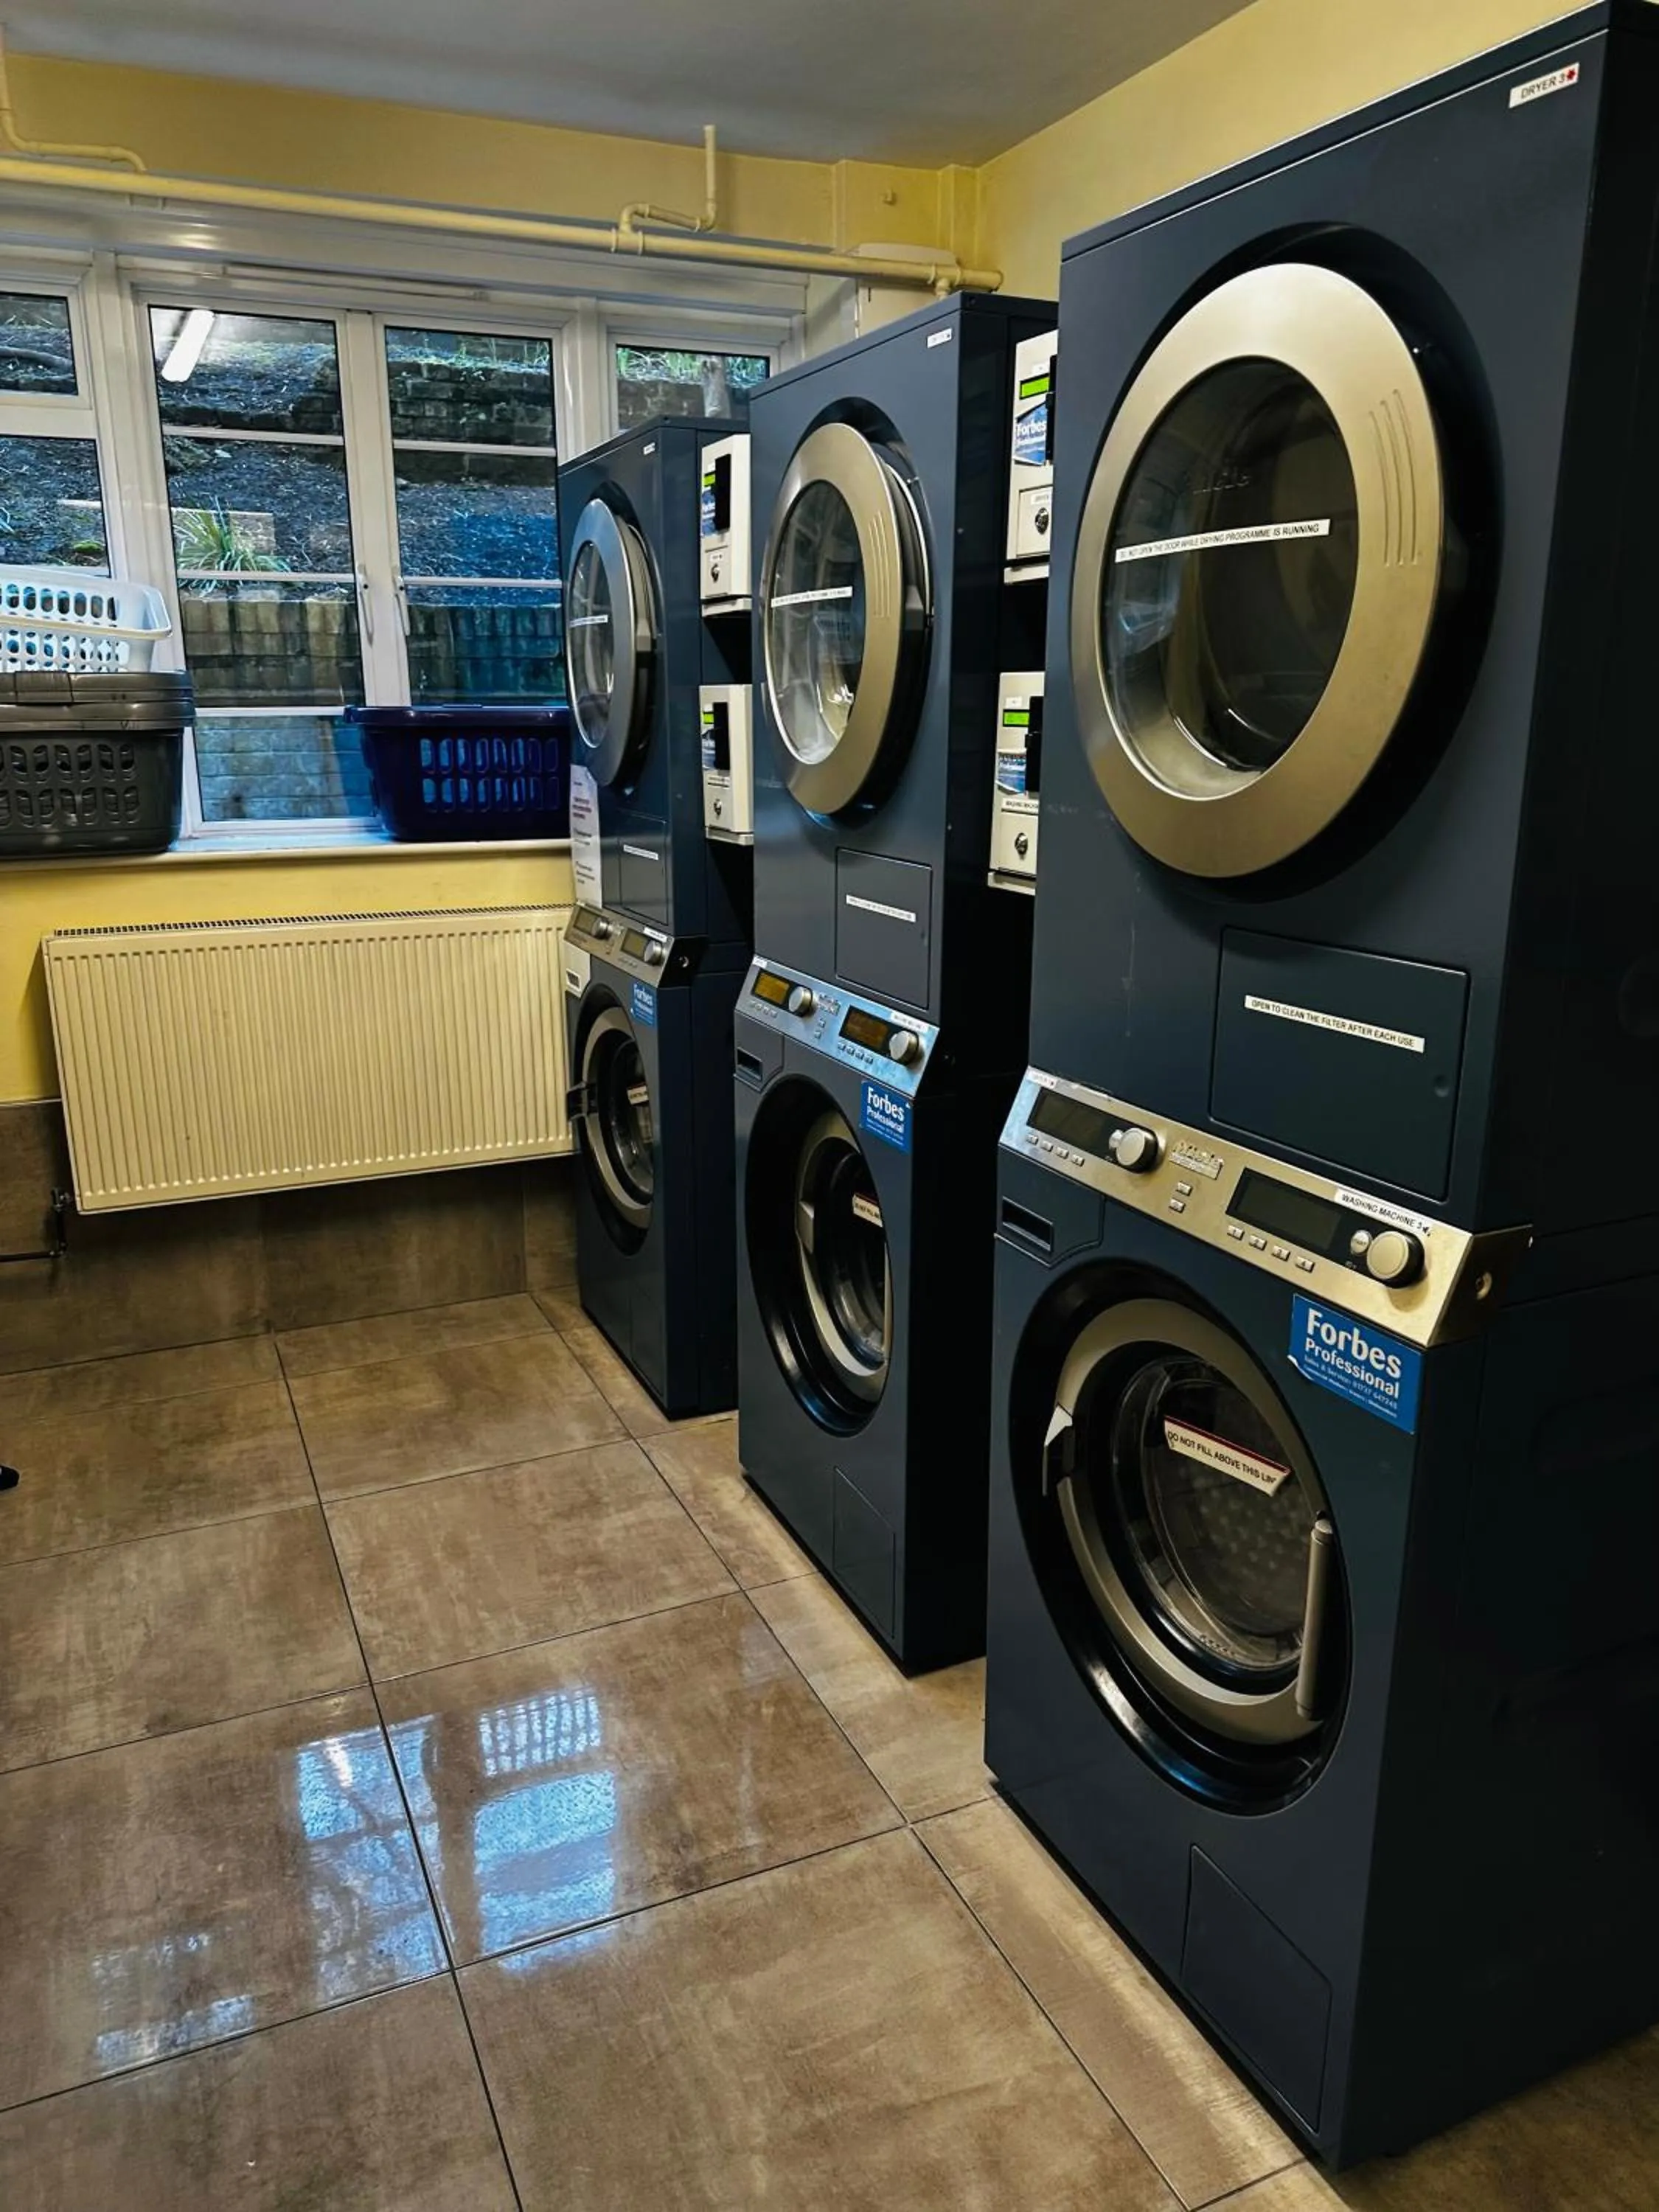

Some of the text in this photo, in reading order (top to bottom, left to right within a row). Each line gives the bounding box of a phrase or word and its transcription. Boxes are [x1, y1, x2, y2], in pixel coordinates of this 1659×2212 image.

[1521, 77, 1557, 99] DRYER
[1225, 529, 1270, 543] PROGRAMME
[1273, 526, 1281, 536] IS
[1282, 523, 1319, 536] RUNNING
[1251, 999, 1415, 1048] OPEN TO CLEAN THE FILTER AFTER EACH USE
[867, 1085, 905, 1121] Forbes
[1341, 1193, 1378, 1214] WASHING
[1378, 1207, 1416, 1227] MACHINE
[1306, 1307, 1402, 1379] Forbes
[1304, 1337, 1400, 1399] Professional
[1167, 1430, 1277, 1484] DO NOT FILL ABOVE THIS LIN
